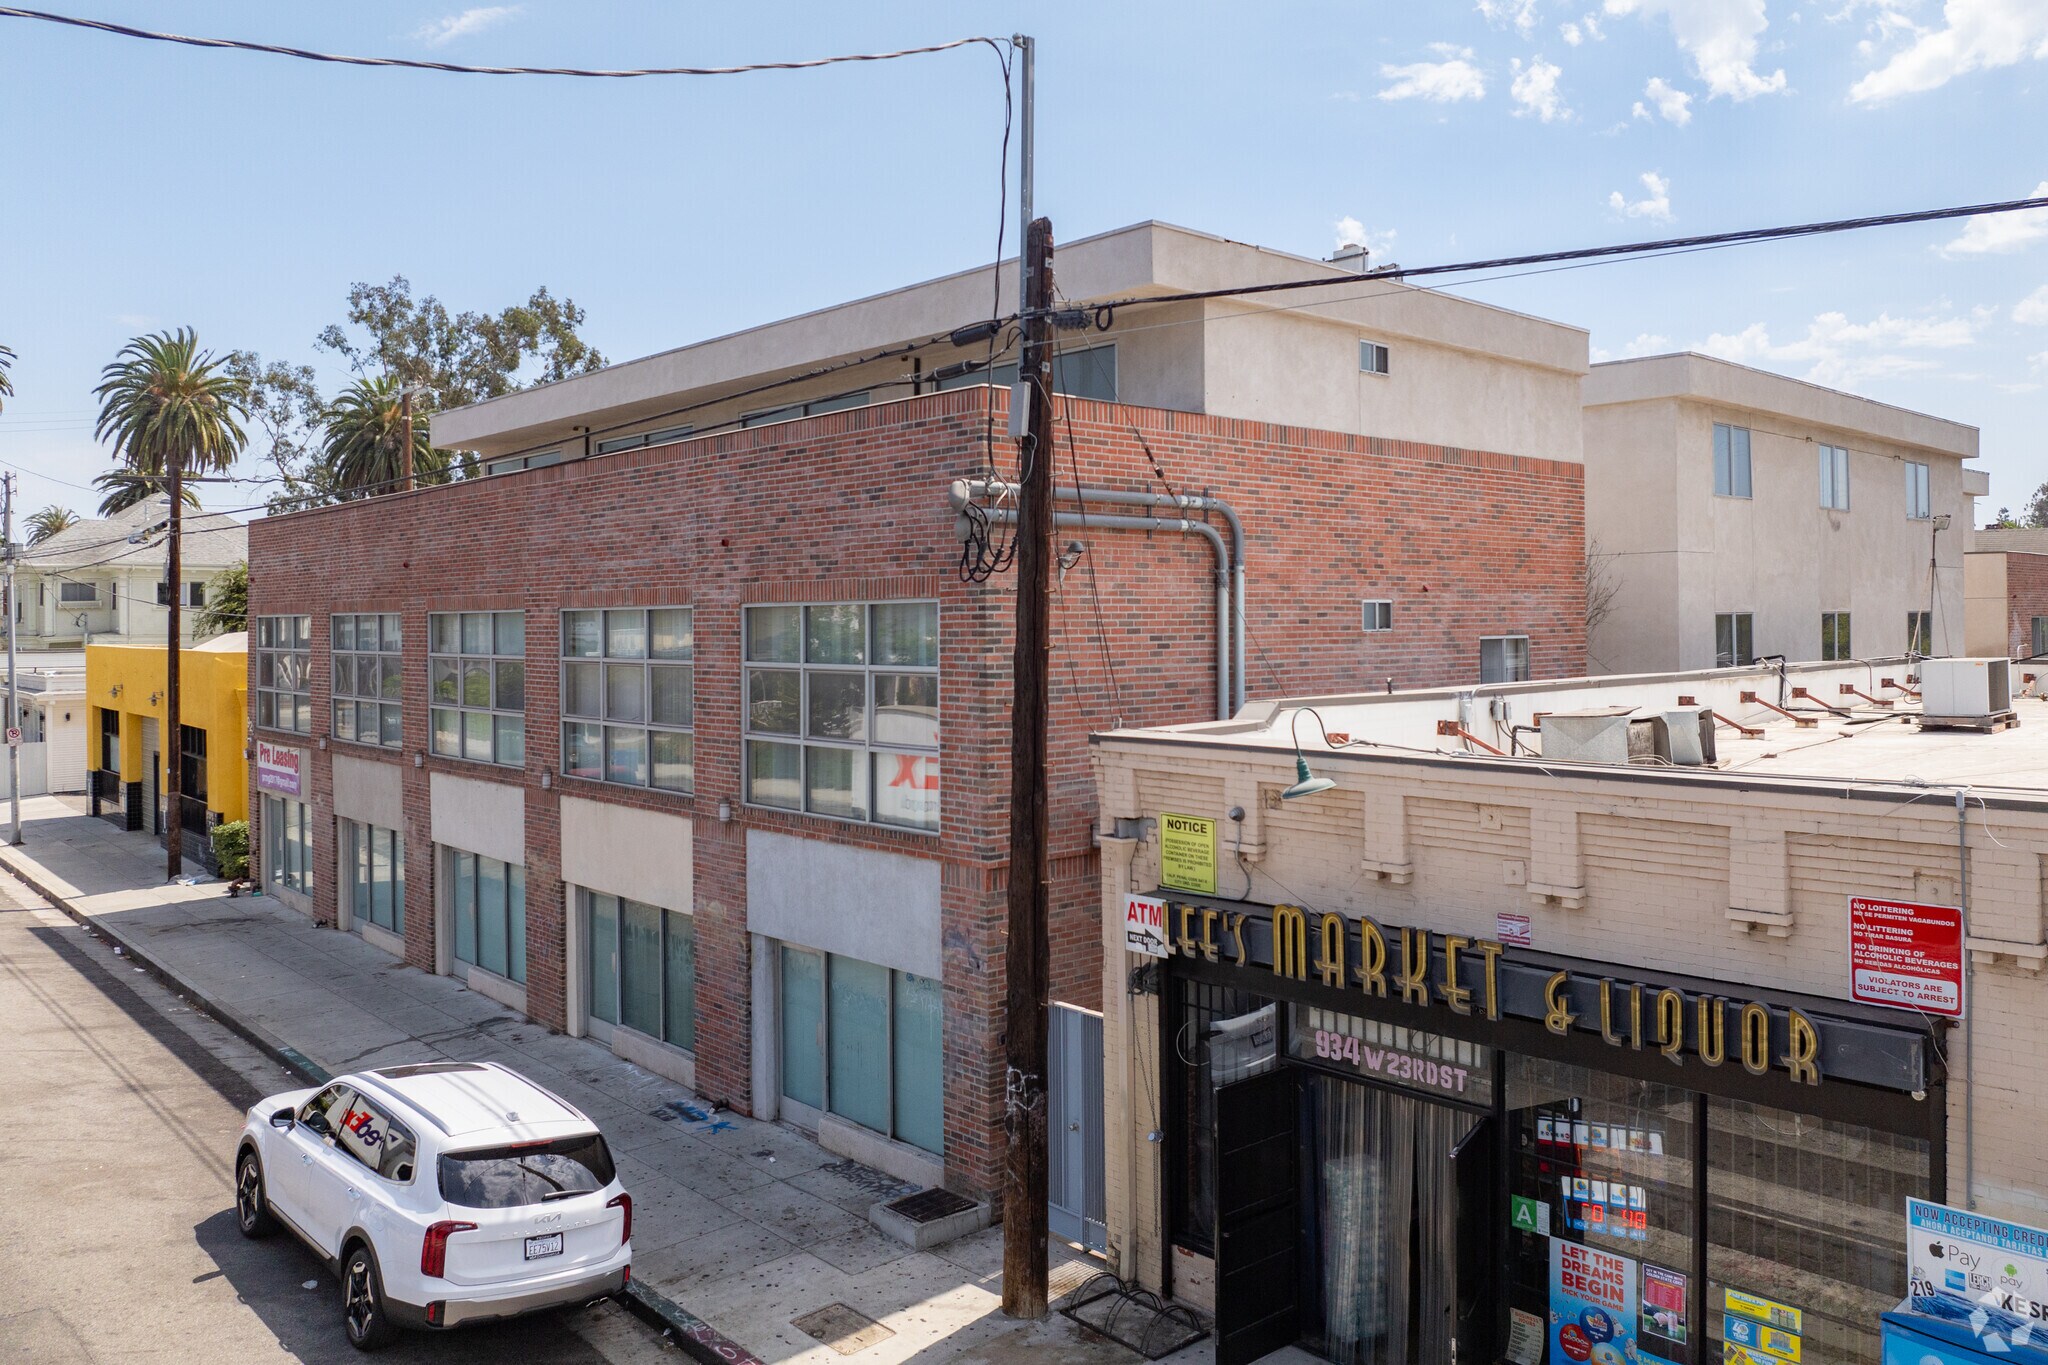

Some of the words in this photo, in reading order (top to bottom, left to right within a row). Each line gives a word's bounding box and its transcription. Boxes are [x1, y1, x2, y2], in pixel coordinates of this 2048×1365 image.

[259, 743, 271, 764] Pre
[272, 745, 299, 774] Leasing
[1167, 819, 1208, 834] NOTICE
[1127, 901, 1162, 928] ATM
[1853, 902, 1866, 910] NO
[1867, 904, 1915, 916] LOITERING
[1853, 922, 1866, 930] NO
[1867, 924, 1914, 936] LITTERING
[1873, 913, 1908, 922] PERMITEN
[1908, 916, 1956, 927] VAGABUNDOS
[1129, 933, 1143, 943] NEXT
[1864, 932, 1884, 940] TIRAR
[1885, 934, 1912, 943] BASURA
[1854, 942, 1866, 950] NO
[1868, 944, 1911, 956] DRINKING
[1913, 950, 1925, 958] OF
[1854, 950, 1903, 962] ALCOHOLIC
[1904, 956, 1959, 970] BEVERAGES
[1864, 960, 1893, 968] BEBIDAS
[1272, 903, 1508, 1022] MARKET
[1544, 970, 1577, 1036] &
[1600, 978, 1821, 1086] LIQUOR
[1857, 983, 1899, 996] SUBJECT
[1901, 989, 1915, 998] TO
[1917, 992, 1956, 1004] ARREST
[1868, 976, 1921, 990] VIOLATORS
[1923, 984, 1943, 993] ARE
[1315, 1030, 1361, 1066] 934
[1363, 1045, 1386, 1071] W
[534, 1213, 562, 1225] KIA
[1516, 1203, 1533, 1225] A
[1915, 1205, 1939, 1221] NOW
[1945, 1212, 2008, 1238] ACCEPTING
[1920, 1218, 1948, 1233] AHORA
[1950, 1226, 1998, 1246] ACEPTANDO
[2001, 1238, 2043, 1258] TARJETAS
[1561, 1243, 1589, 1262] LET
[1593, 1252, 1624, 1273] THE
[1948, 1244, 1981, 1271] Pay
[1561, 1256, 1624, 1286] DREAMS
[1561, 1270, 1624, 1304] BEGIN
[1910, 1280, 1935, 1297] 219
[2000, 1275, 2023, 1289] pay
[1561, 1287, 1579, 1298] PICK
[1580, 1293, 1601, 1305] YOUR
[1602, 1300, 1624, 1312] GAME
